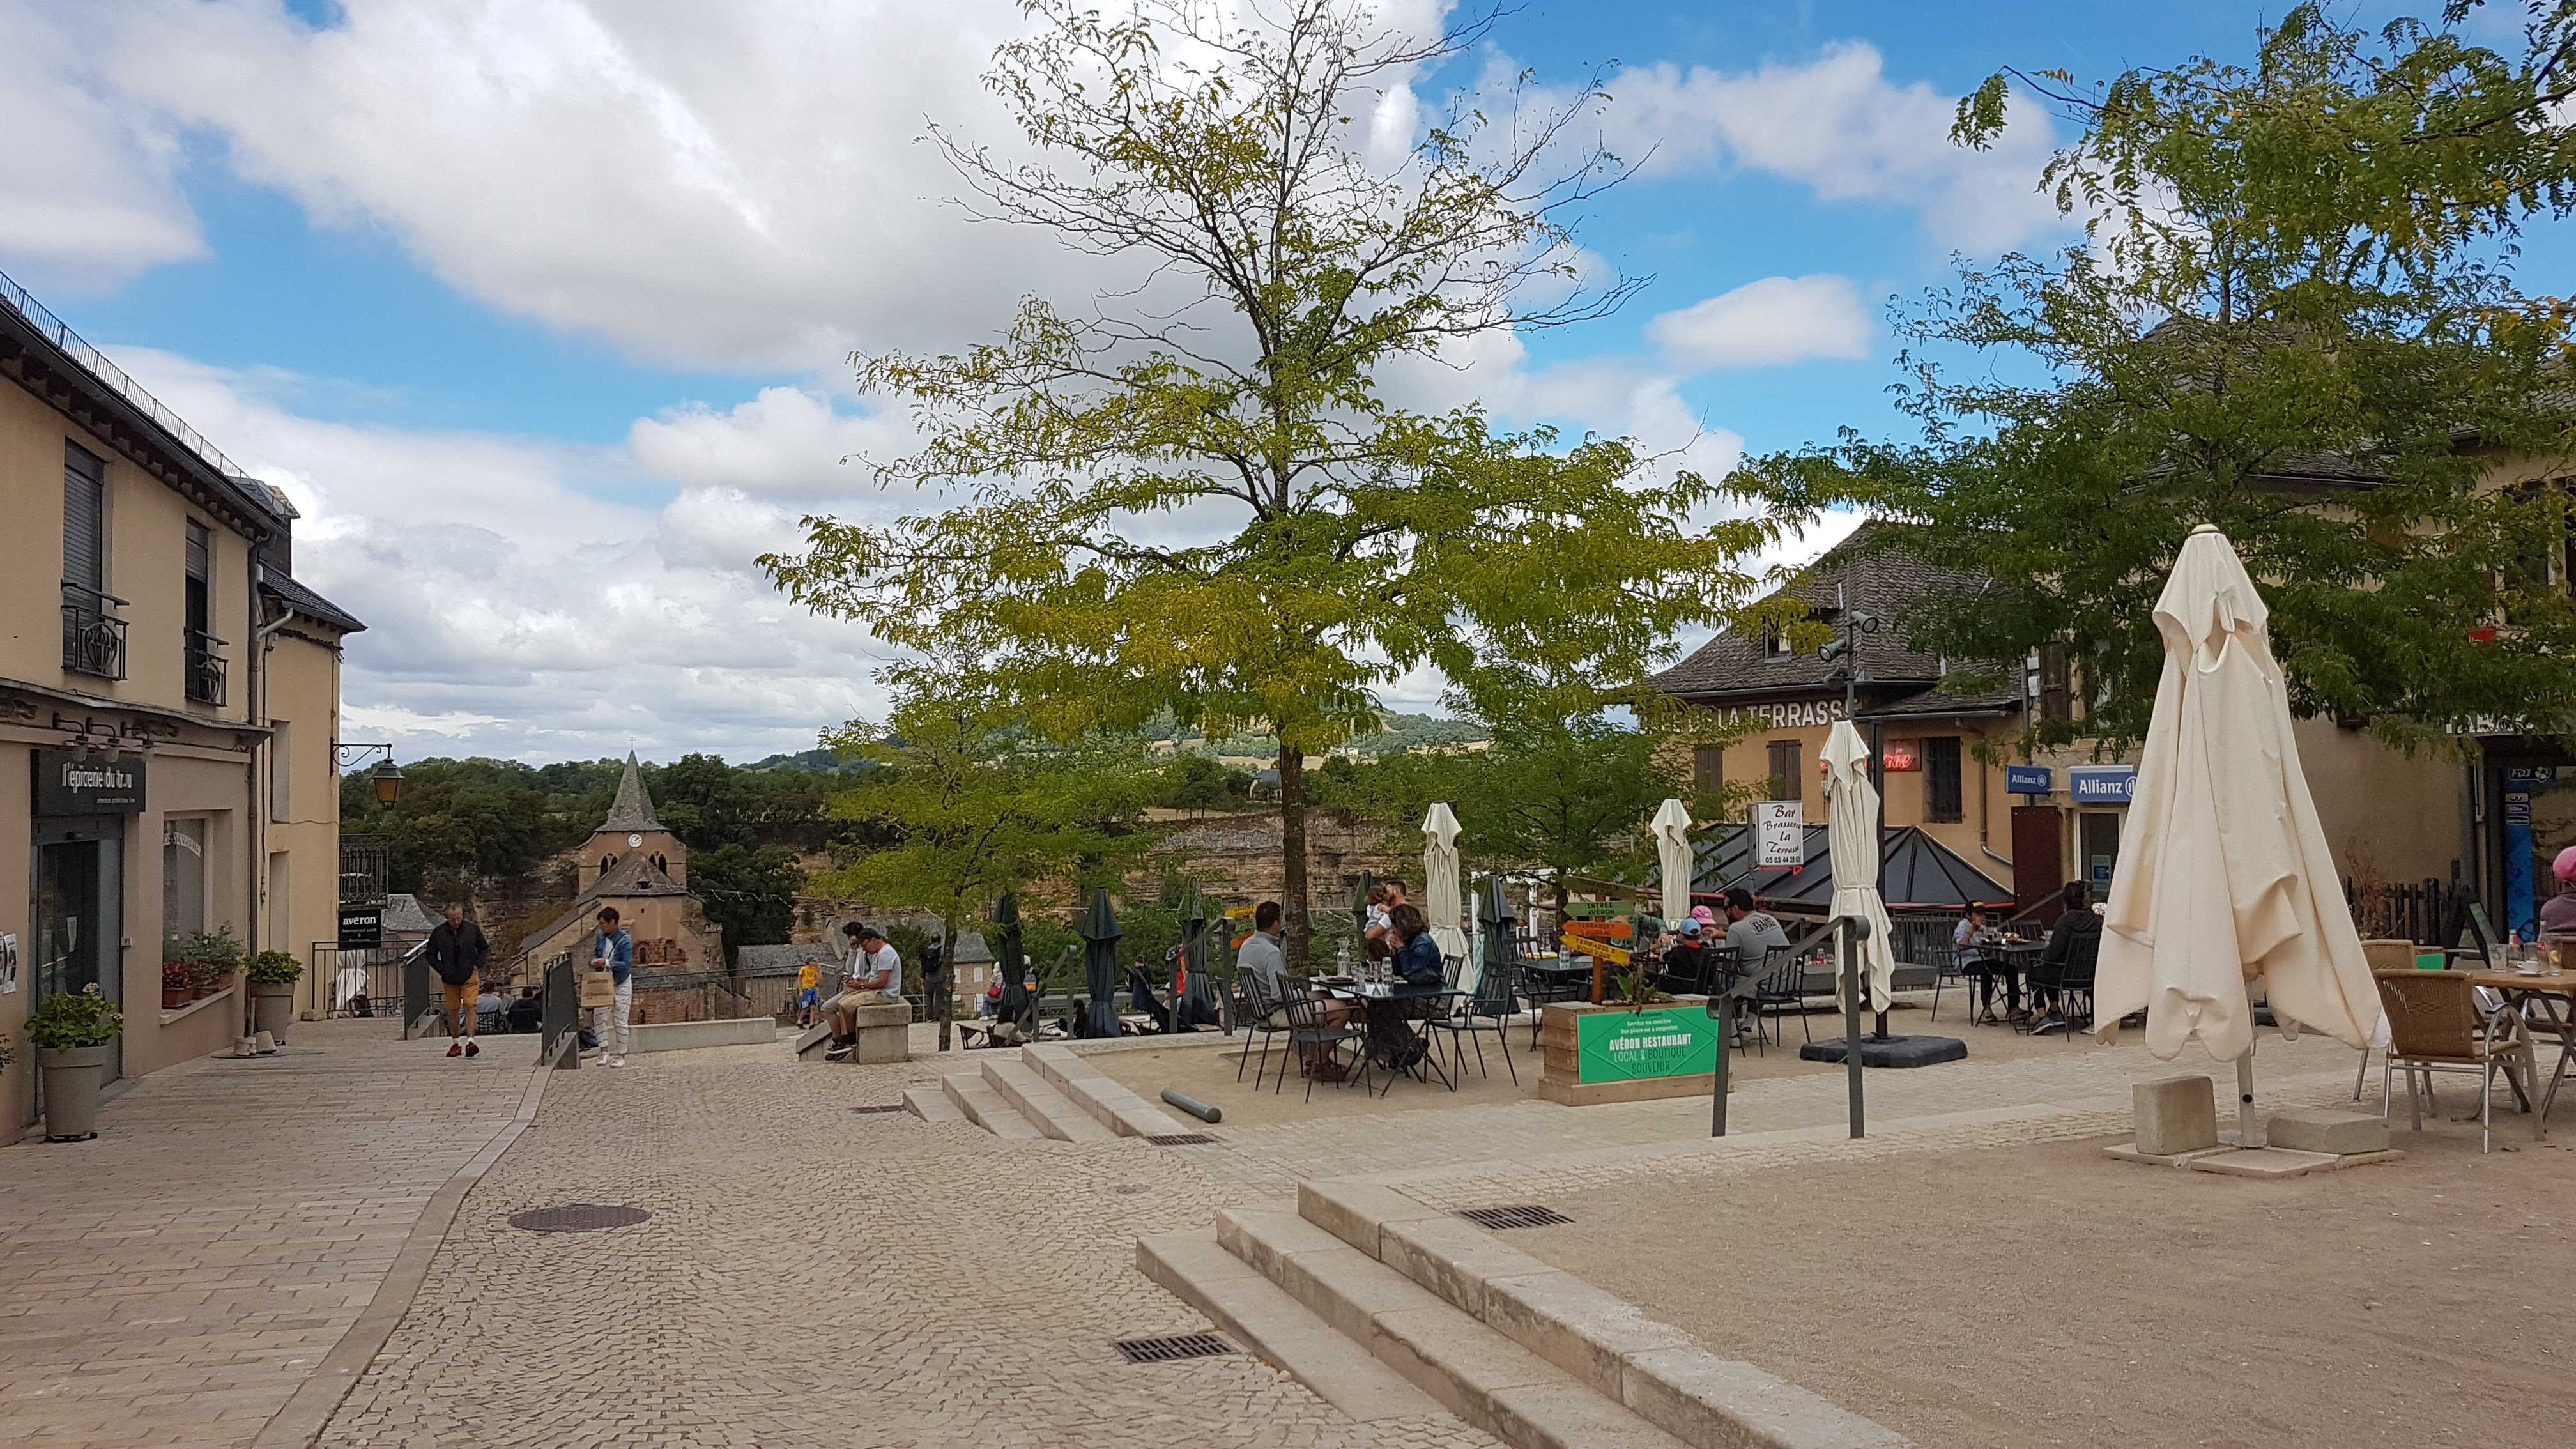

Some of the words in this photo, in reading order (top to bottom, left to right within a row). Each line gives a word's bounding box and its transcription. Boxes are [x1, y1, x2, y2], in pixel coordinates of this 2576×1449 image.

[104, 767, 115, 788] du
[2012, 774, 2036, 784] Allianz
[2078, 779, 2122, 793] Allianz
[1771, 804, 1795, 818] Bar
[1609, 1036, 1640, 1051] AVÉRON
[1643, 1034, 1692, 1048] RESTAURANT
[1614, 1052, 1637, 1063] LOCAL
[1640, 1050, 1646, 1061] &
[1648, 1046, 1686, 1060] BOUTIQUE
[1631, 1060, 1671, 1075] SOUVENIR
